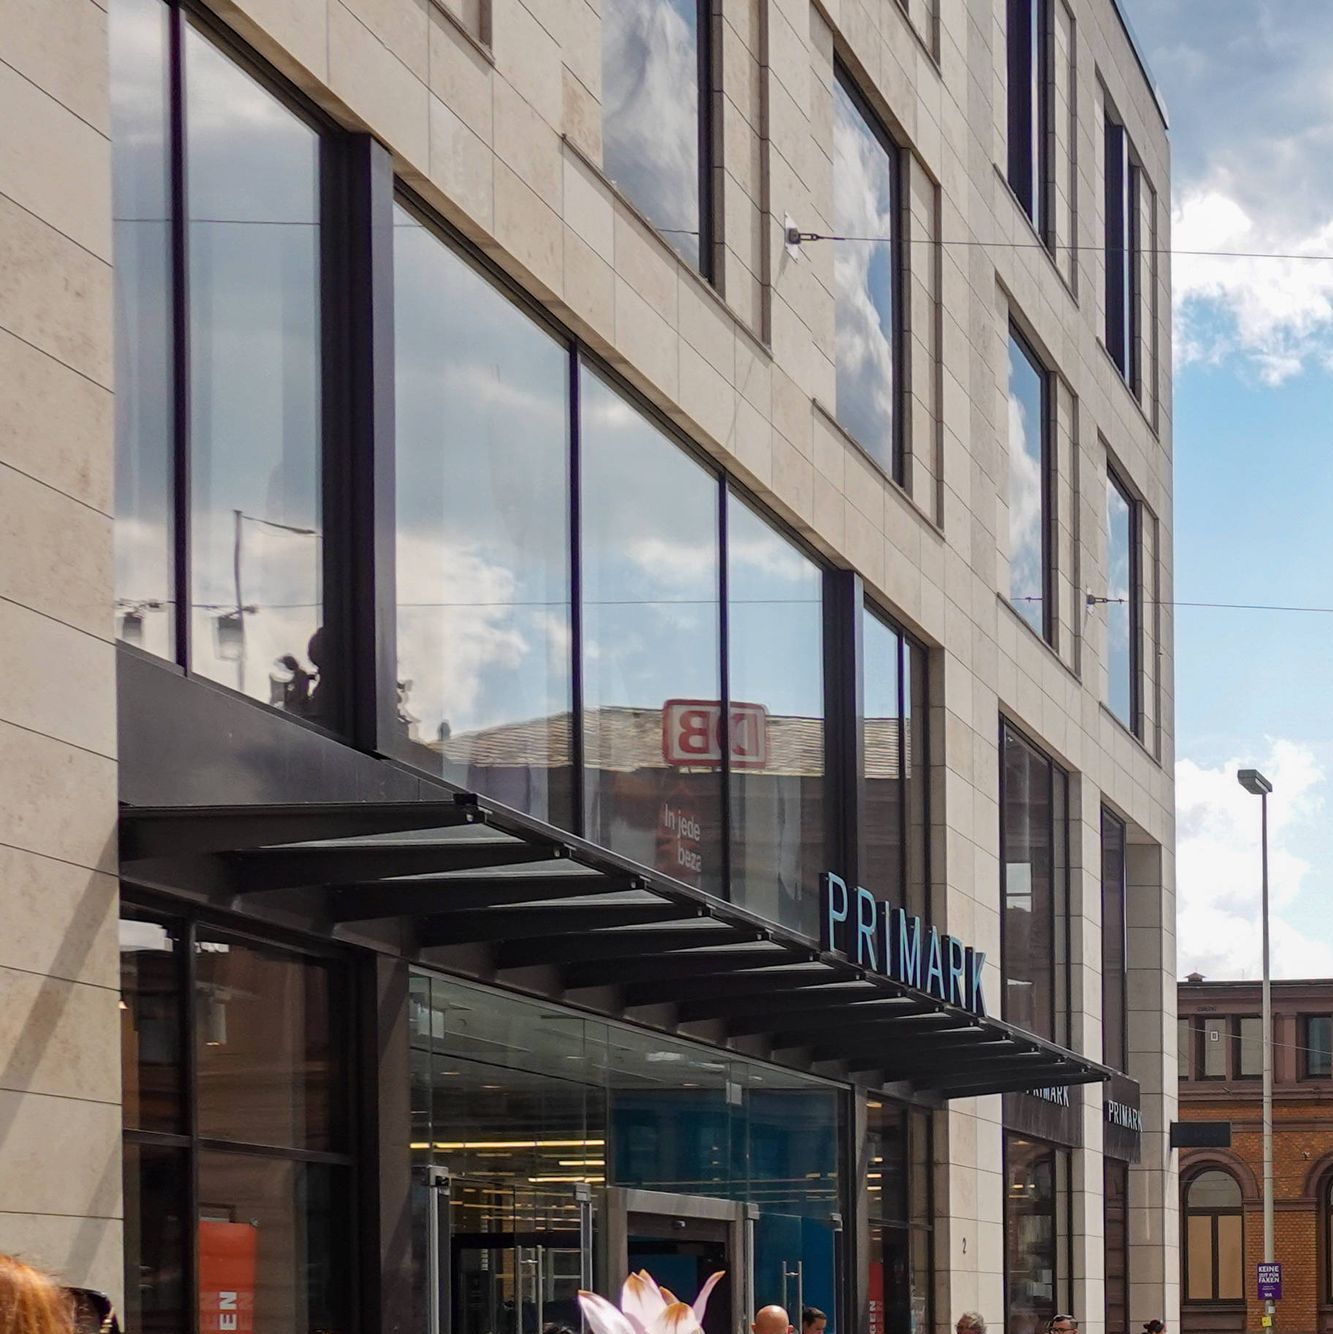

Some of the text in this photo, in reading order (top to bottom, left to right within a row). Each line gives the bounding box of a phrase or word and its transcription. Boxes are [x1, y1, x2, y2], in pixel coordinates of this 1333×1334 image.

[664, 804, 701, 842] In jede
[828, 871, 988, 1018] PRIMARK
[962, 1237, 967, 1255] 2
